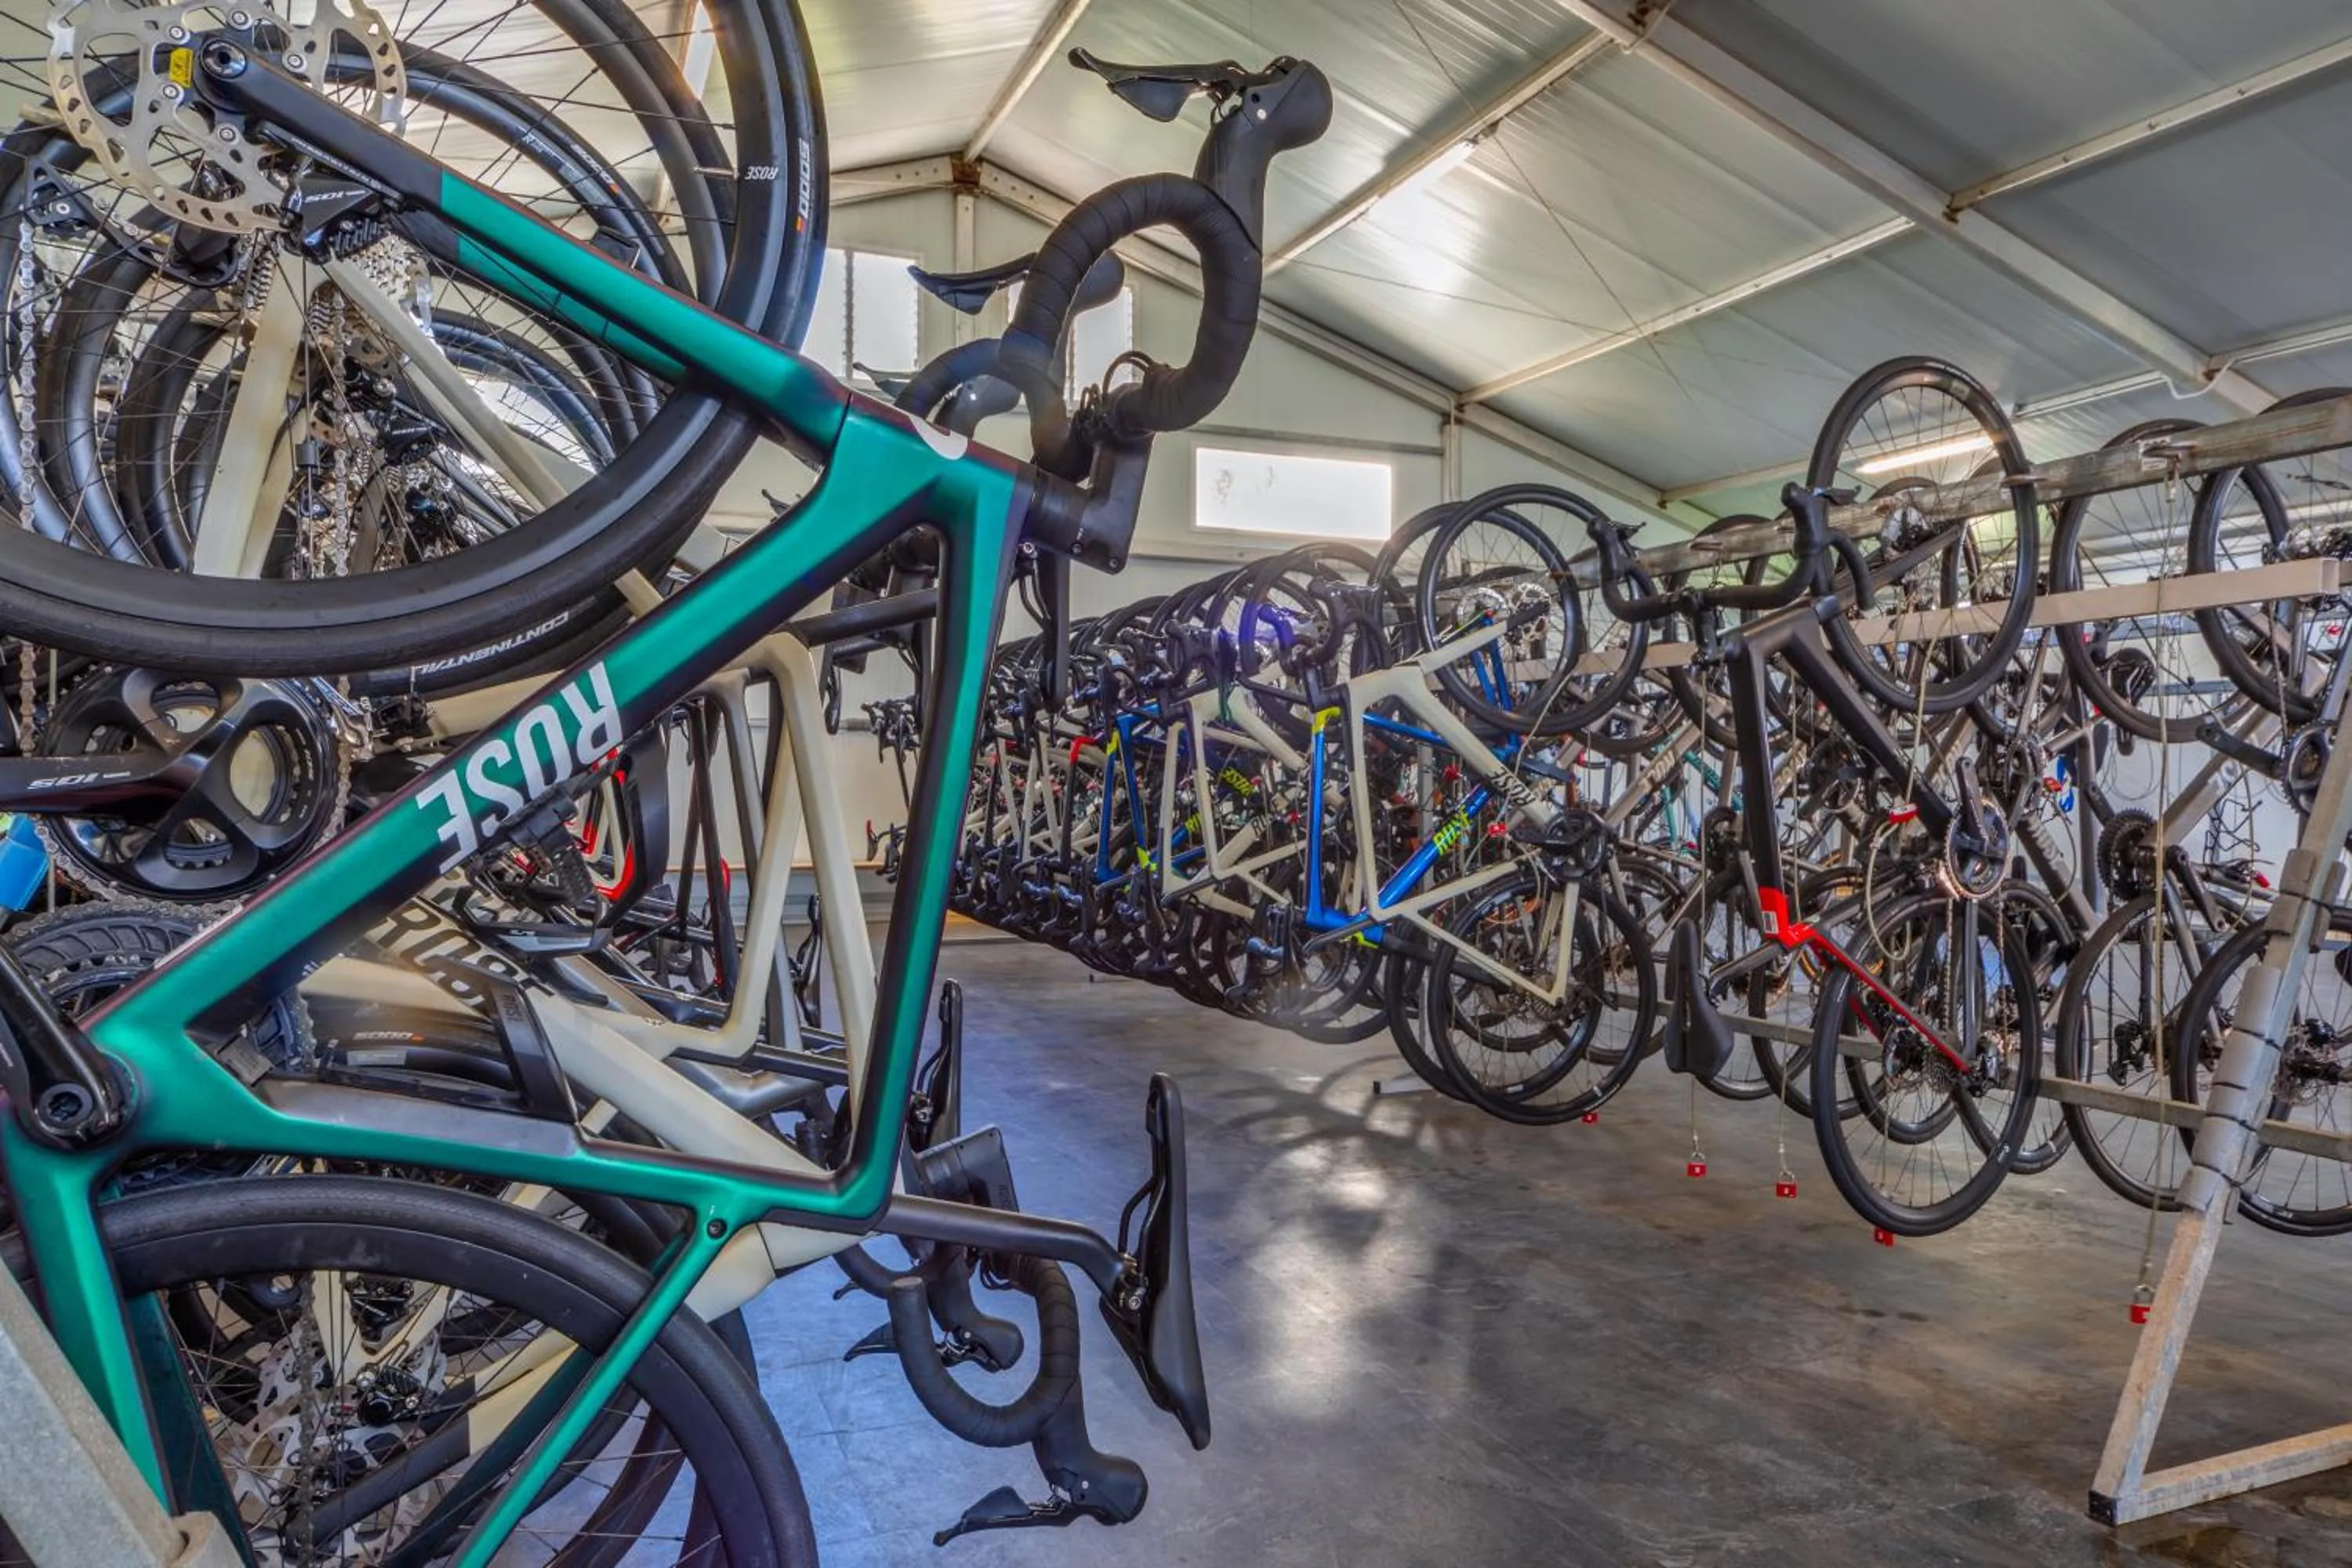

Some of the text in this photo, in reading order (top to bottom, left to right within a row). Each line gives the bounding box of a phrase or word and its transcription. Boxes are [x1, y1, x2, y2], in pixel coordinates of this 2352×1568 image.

[744, 165, 779, 180] ROSE
[797, 137, 810, 220] 5000
[418, 612, 569, 673] CONTINENTAL
[26, 772, 99, 790] 105
[417, 662, 622, 873] ROSE
[1486, 768, 1536, 806] ROSE
